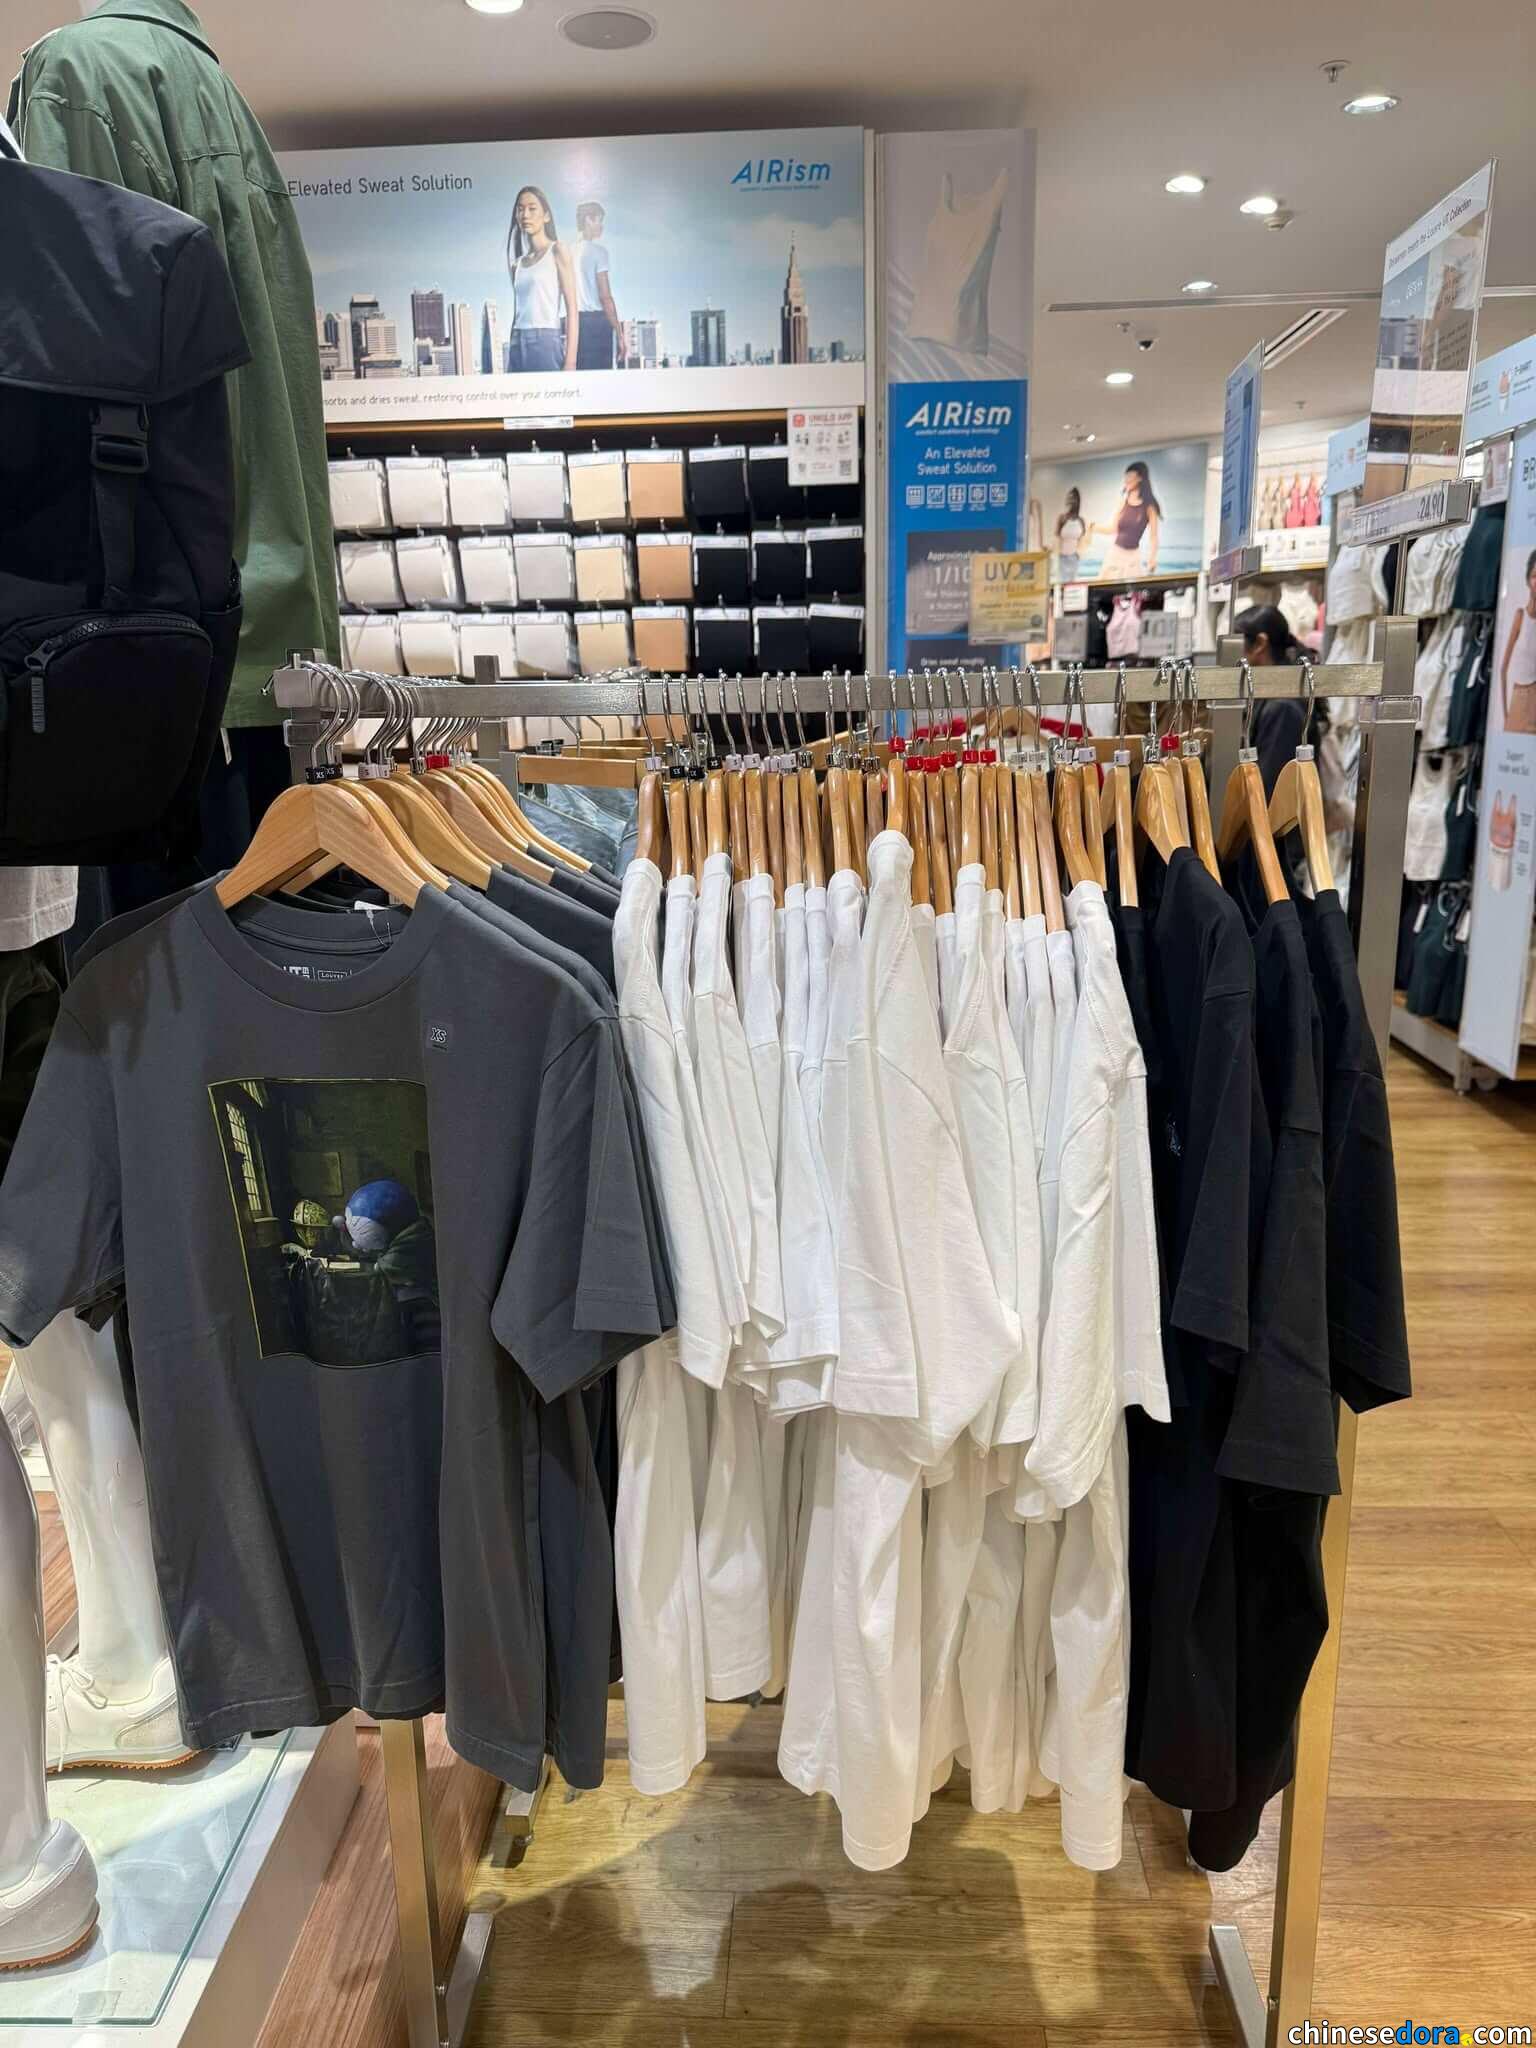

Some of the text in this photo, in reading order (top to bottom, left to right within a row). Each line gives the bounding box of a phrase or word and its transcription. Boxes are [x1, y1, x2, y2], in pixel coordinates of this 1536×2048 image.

[730, 158, 831, 184] AIRism
[288, 173, 473, 197] Elevated Sweat Solution
[905, 400, 1012, 428] AIRism
[924, 445, 990, 460] An Elevated
[917, 462, 997, 476] Sweat Solution
[430, 1027, 447, 1043] XS
